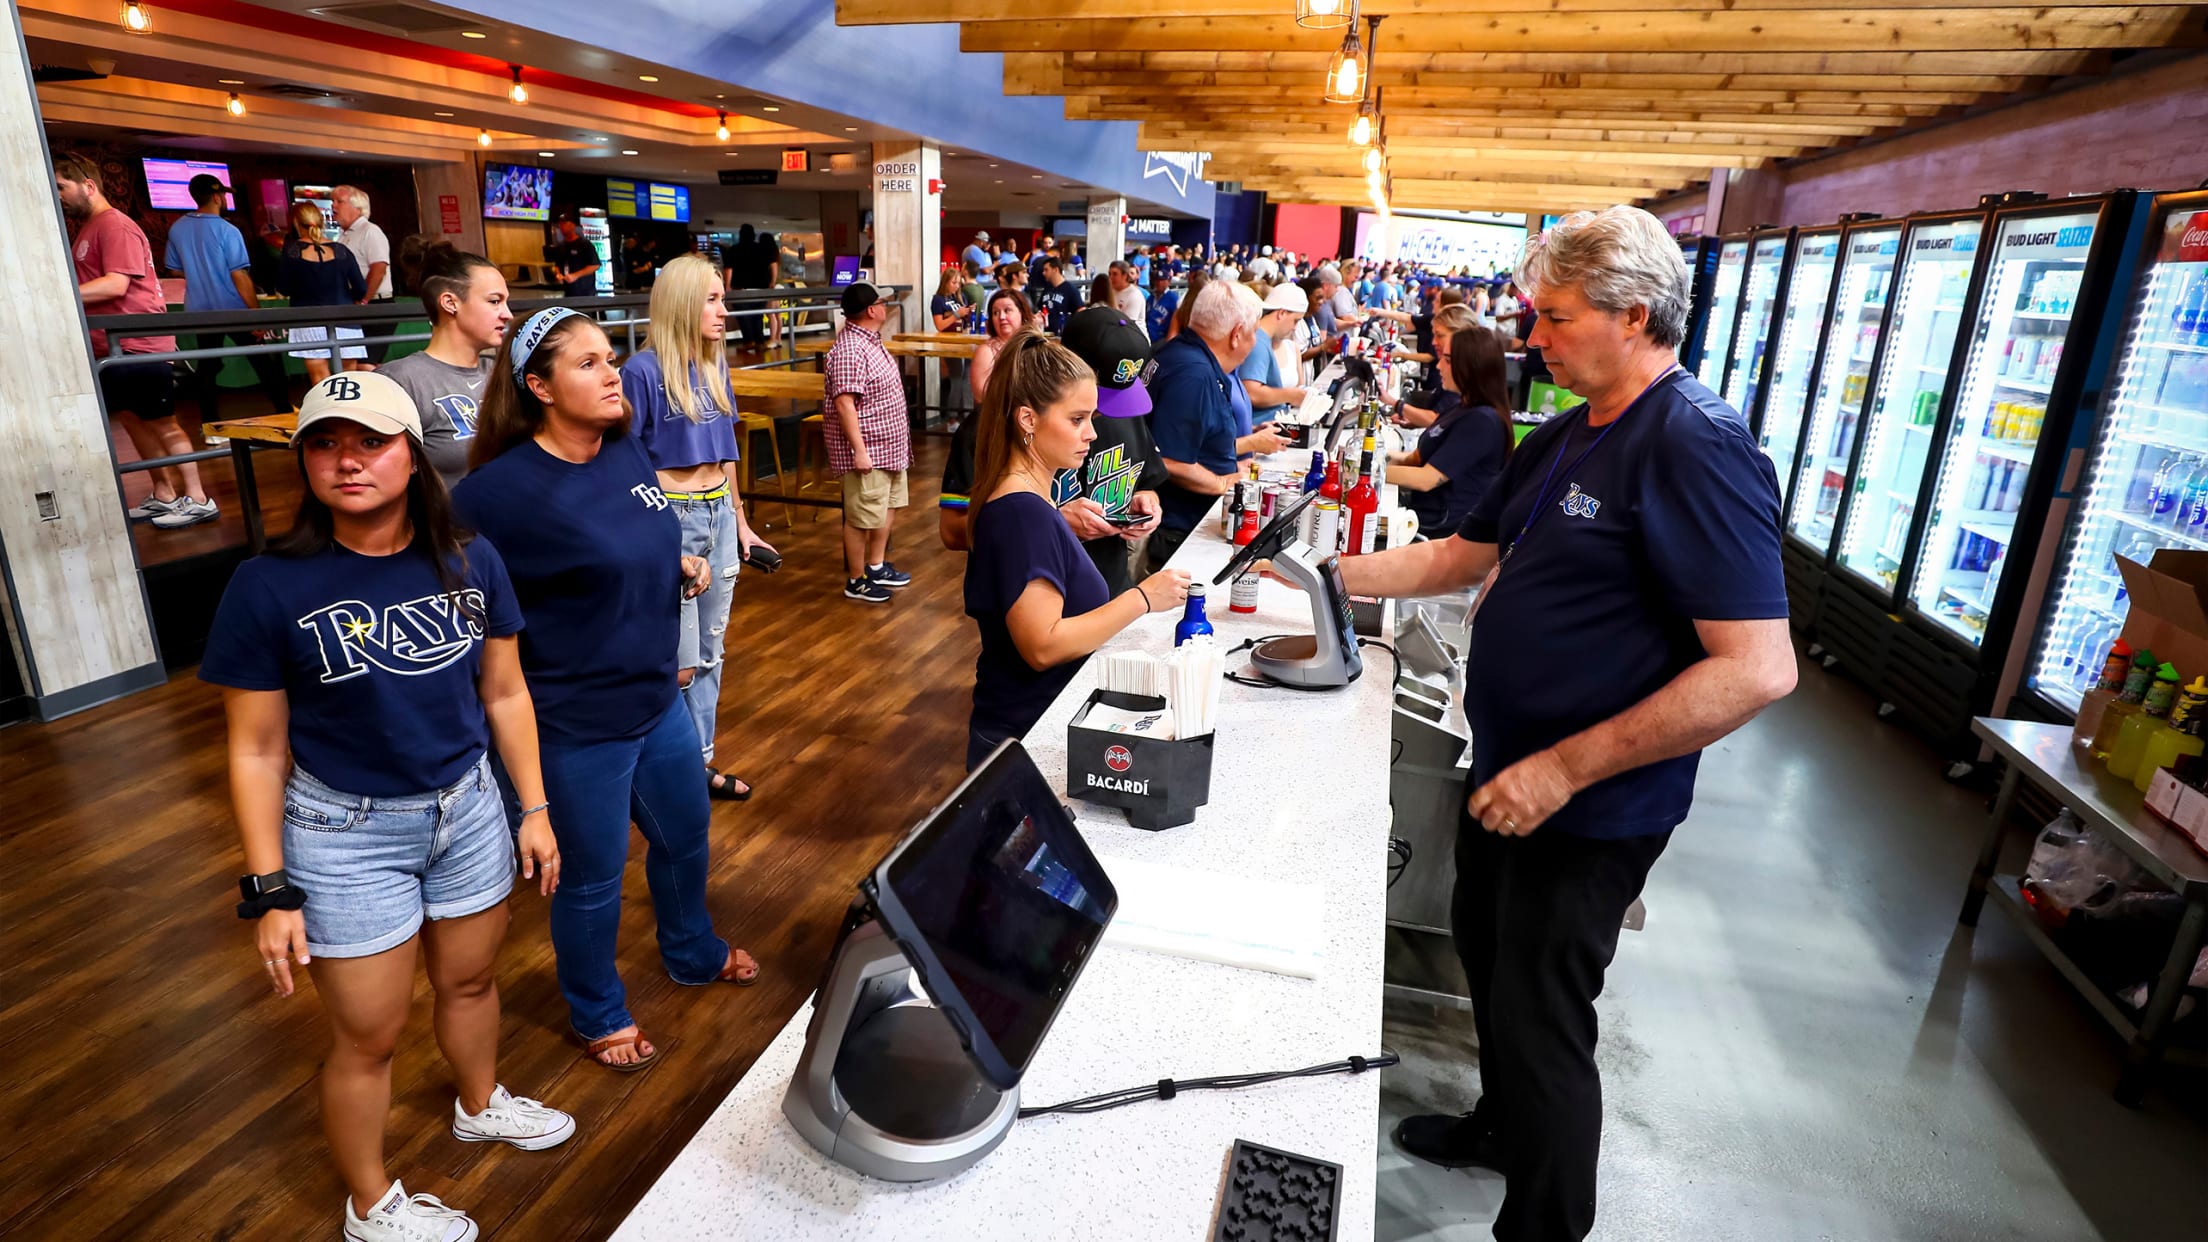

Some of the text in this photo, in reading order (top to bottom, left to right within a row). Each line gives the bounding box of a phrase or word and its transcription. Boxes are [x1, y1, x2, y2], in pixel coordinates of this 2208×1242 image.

[787, 153, 803, 169] EXIT
[876, 163, 917, 174] ORDER
[881, 180, 912, 190] HERE
[1138, 219, 1170, 234] MATTER
[1915, 239, 1931, 250] BUD
[1930, 238, 1953, 249] LIGHT
[2006, 234, 2025, 247] BUD
[2026, 231, 2057, 246] LIGHT
[525, 315, 550, 351] RAYS
[323, 376, 361, 401] TB
[631, 483, 669, 512] TB
[297, 588, 487, 684] RAYS
[1087, 773, 1150, 796] BACARDÍ
